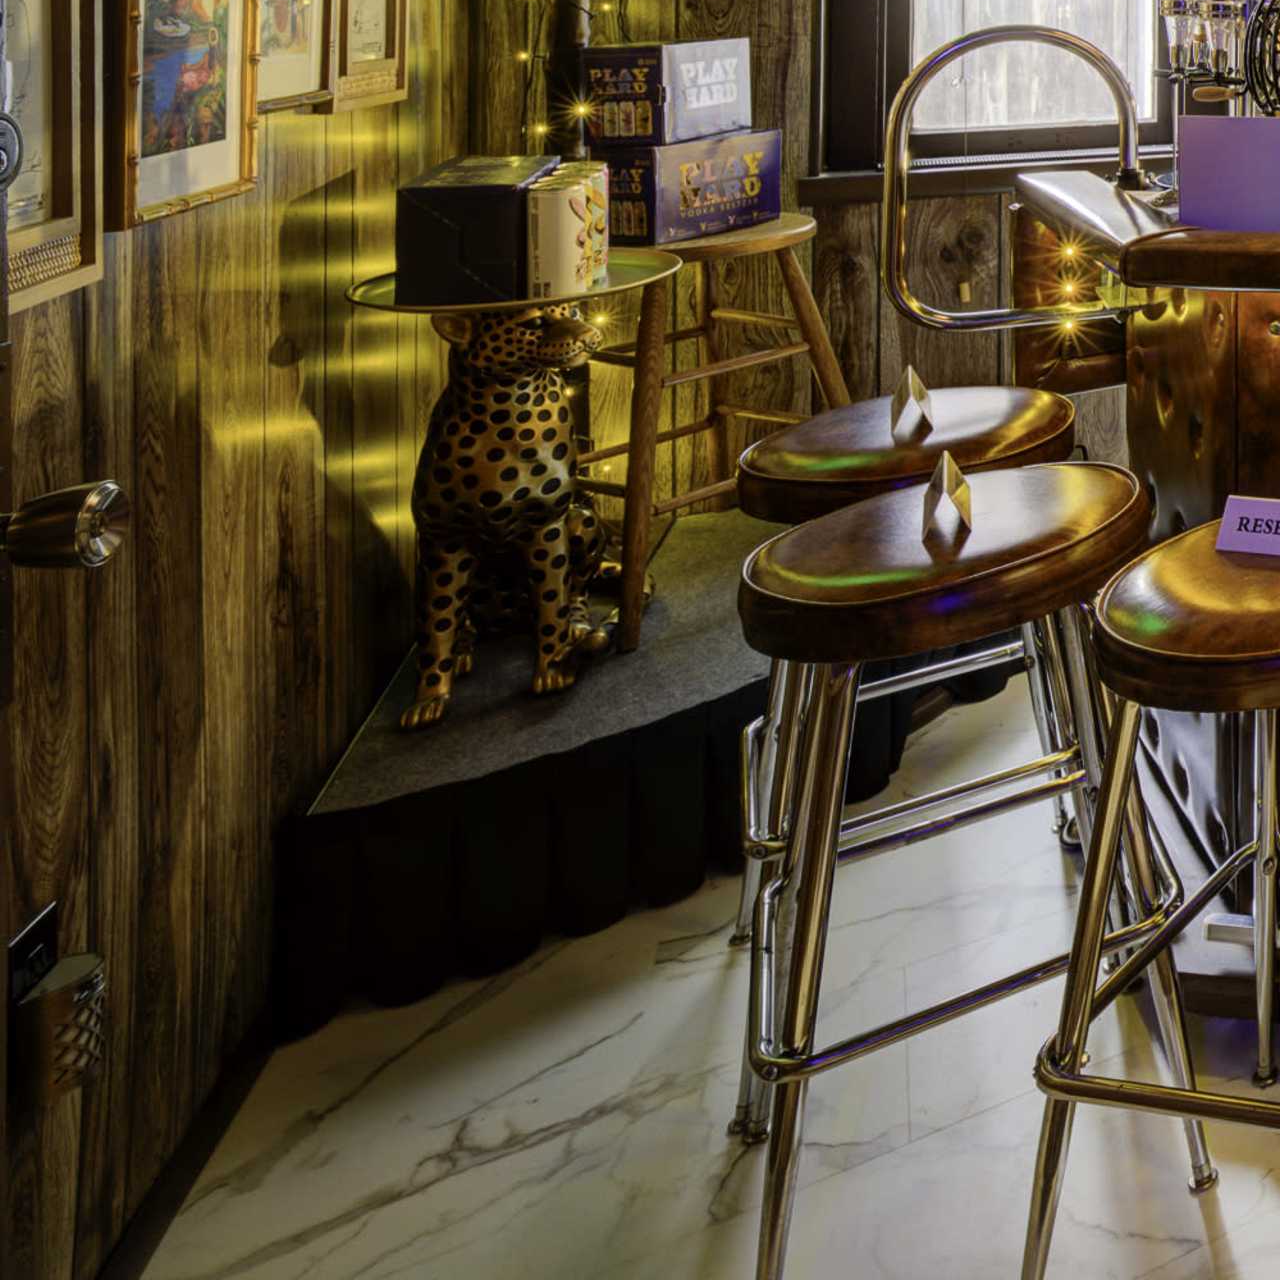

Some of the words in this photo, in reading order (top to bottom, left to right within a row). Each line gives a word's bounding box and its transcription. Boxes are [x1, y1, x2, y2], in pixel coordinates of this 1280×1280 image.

[590, 68, 649, 82] PLAY
[680, 58, 738, 87] PLAY
[679, 151, 764, 187] PLAY
[680, 206, 715, 218] VODKA
